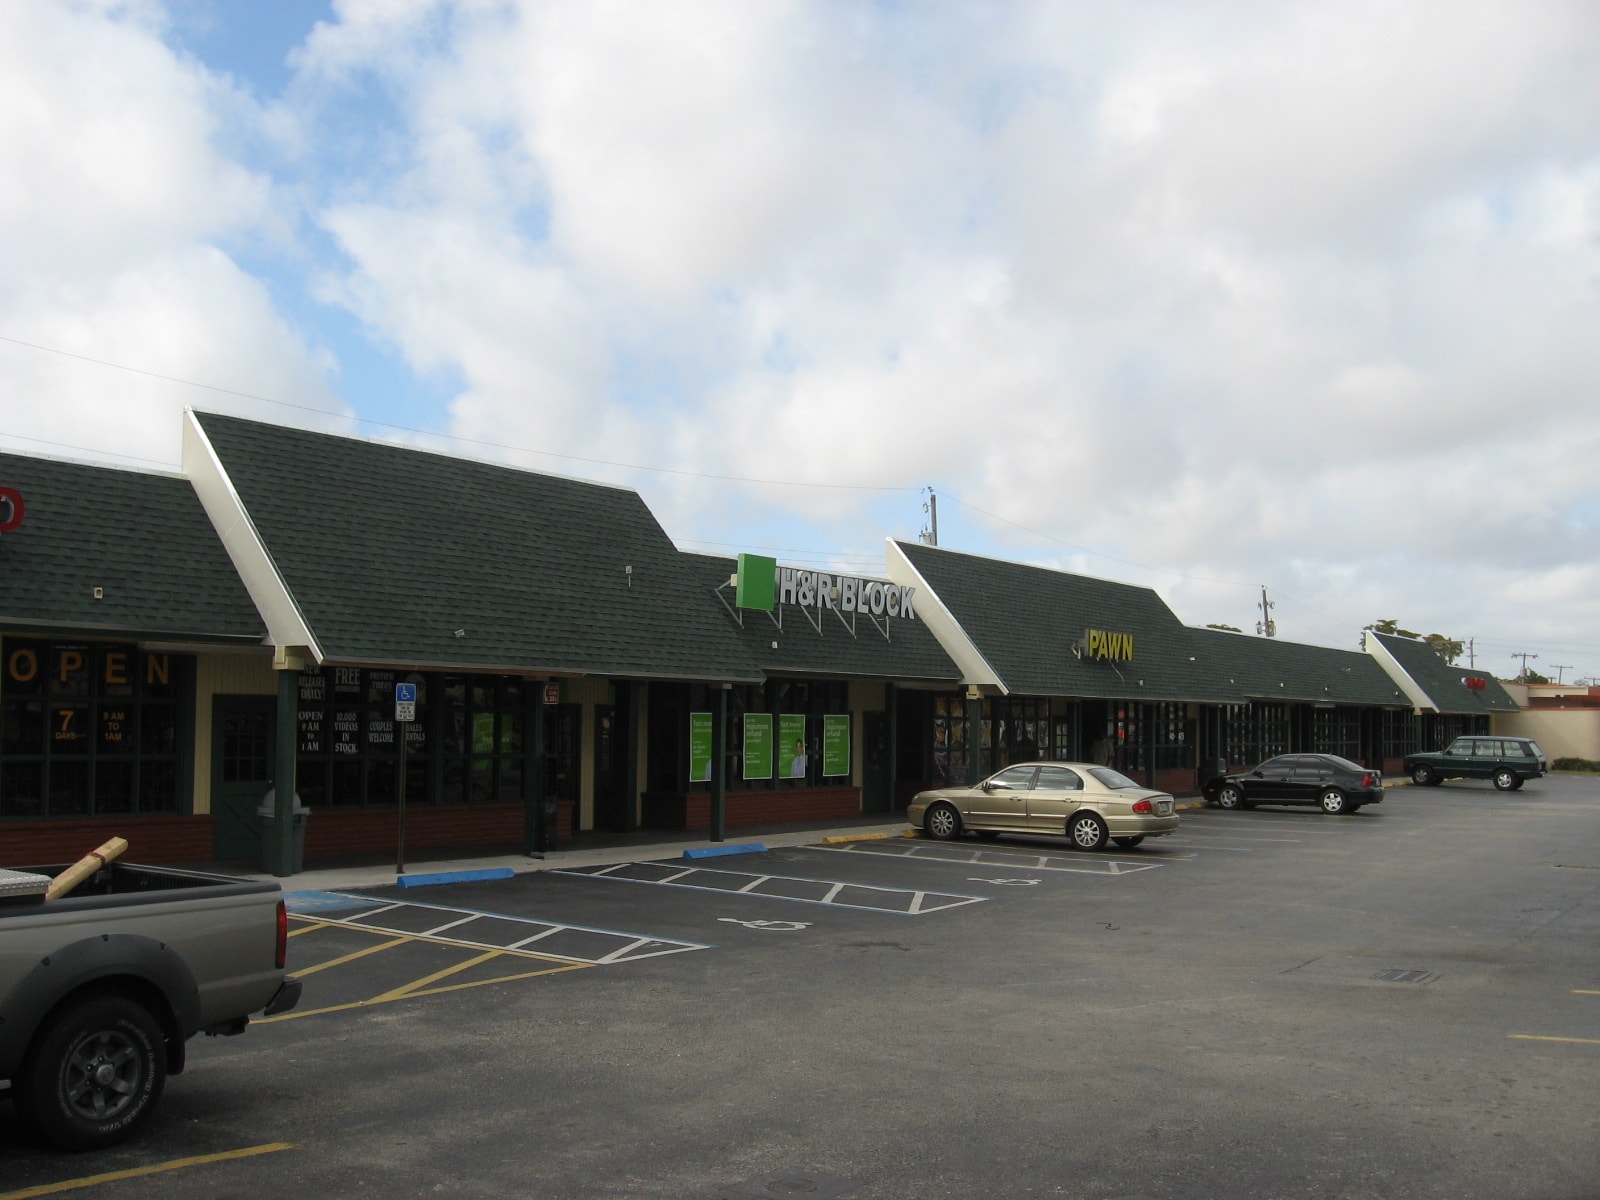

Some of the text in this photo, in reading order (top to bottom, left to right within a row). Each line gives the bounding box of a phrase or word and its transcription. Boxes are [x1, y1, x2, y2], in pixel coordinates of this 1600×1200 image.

[779, 568, 916, 620] H&R BLOCK
[1089, 628, 1133, 661] PAWN
[9, 649, 169, 684] OPEN
[335, 667, 361, 685] FREE
[301, 688, 322, 700] DAILY
[59, 710, 74, 731] 7
[111, 712, 125, 721] AM
[299, 711, 324, 721] OPEN
[107, 722, 120, 731] TO
[307, 723, 320, 731] AM
[334, 722, 359, 731] VIDEOS
[370, 721, 393, 731] COUPLES
[55, 731, 77, 740] DAYS
[342, 733, 350, 742] IN
[369, 733, 394, 743] WELCOME
[406, 732, 426, 741] ENTALS
[306, 742, 319, 751] AM
